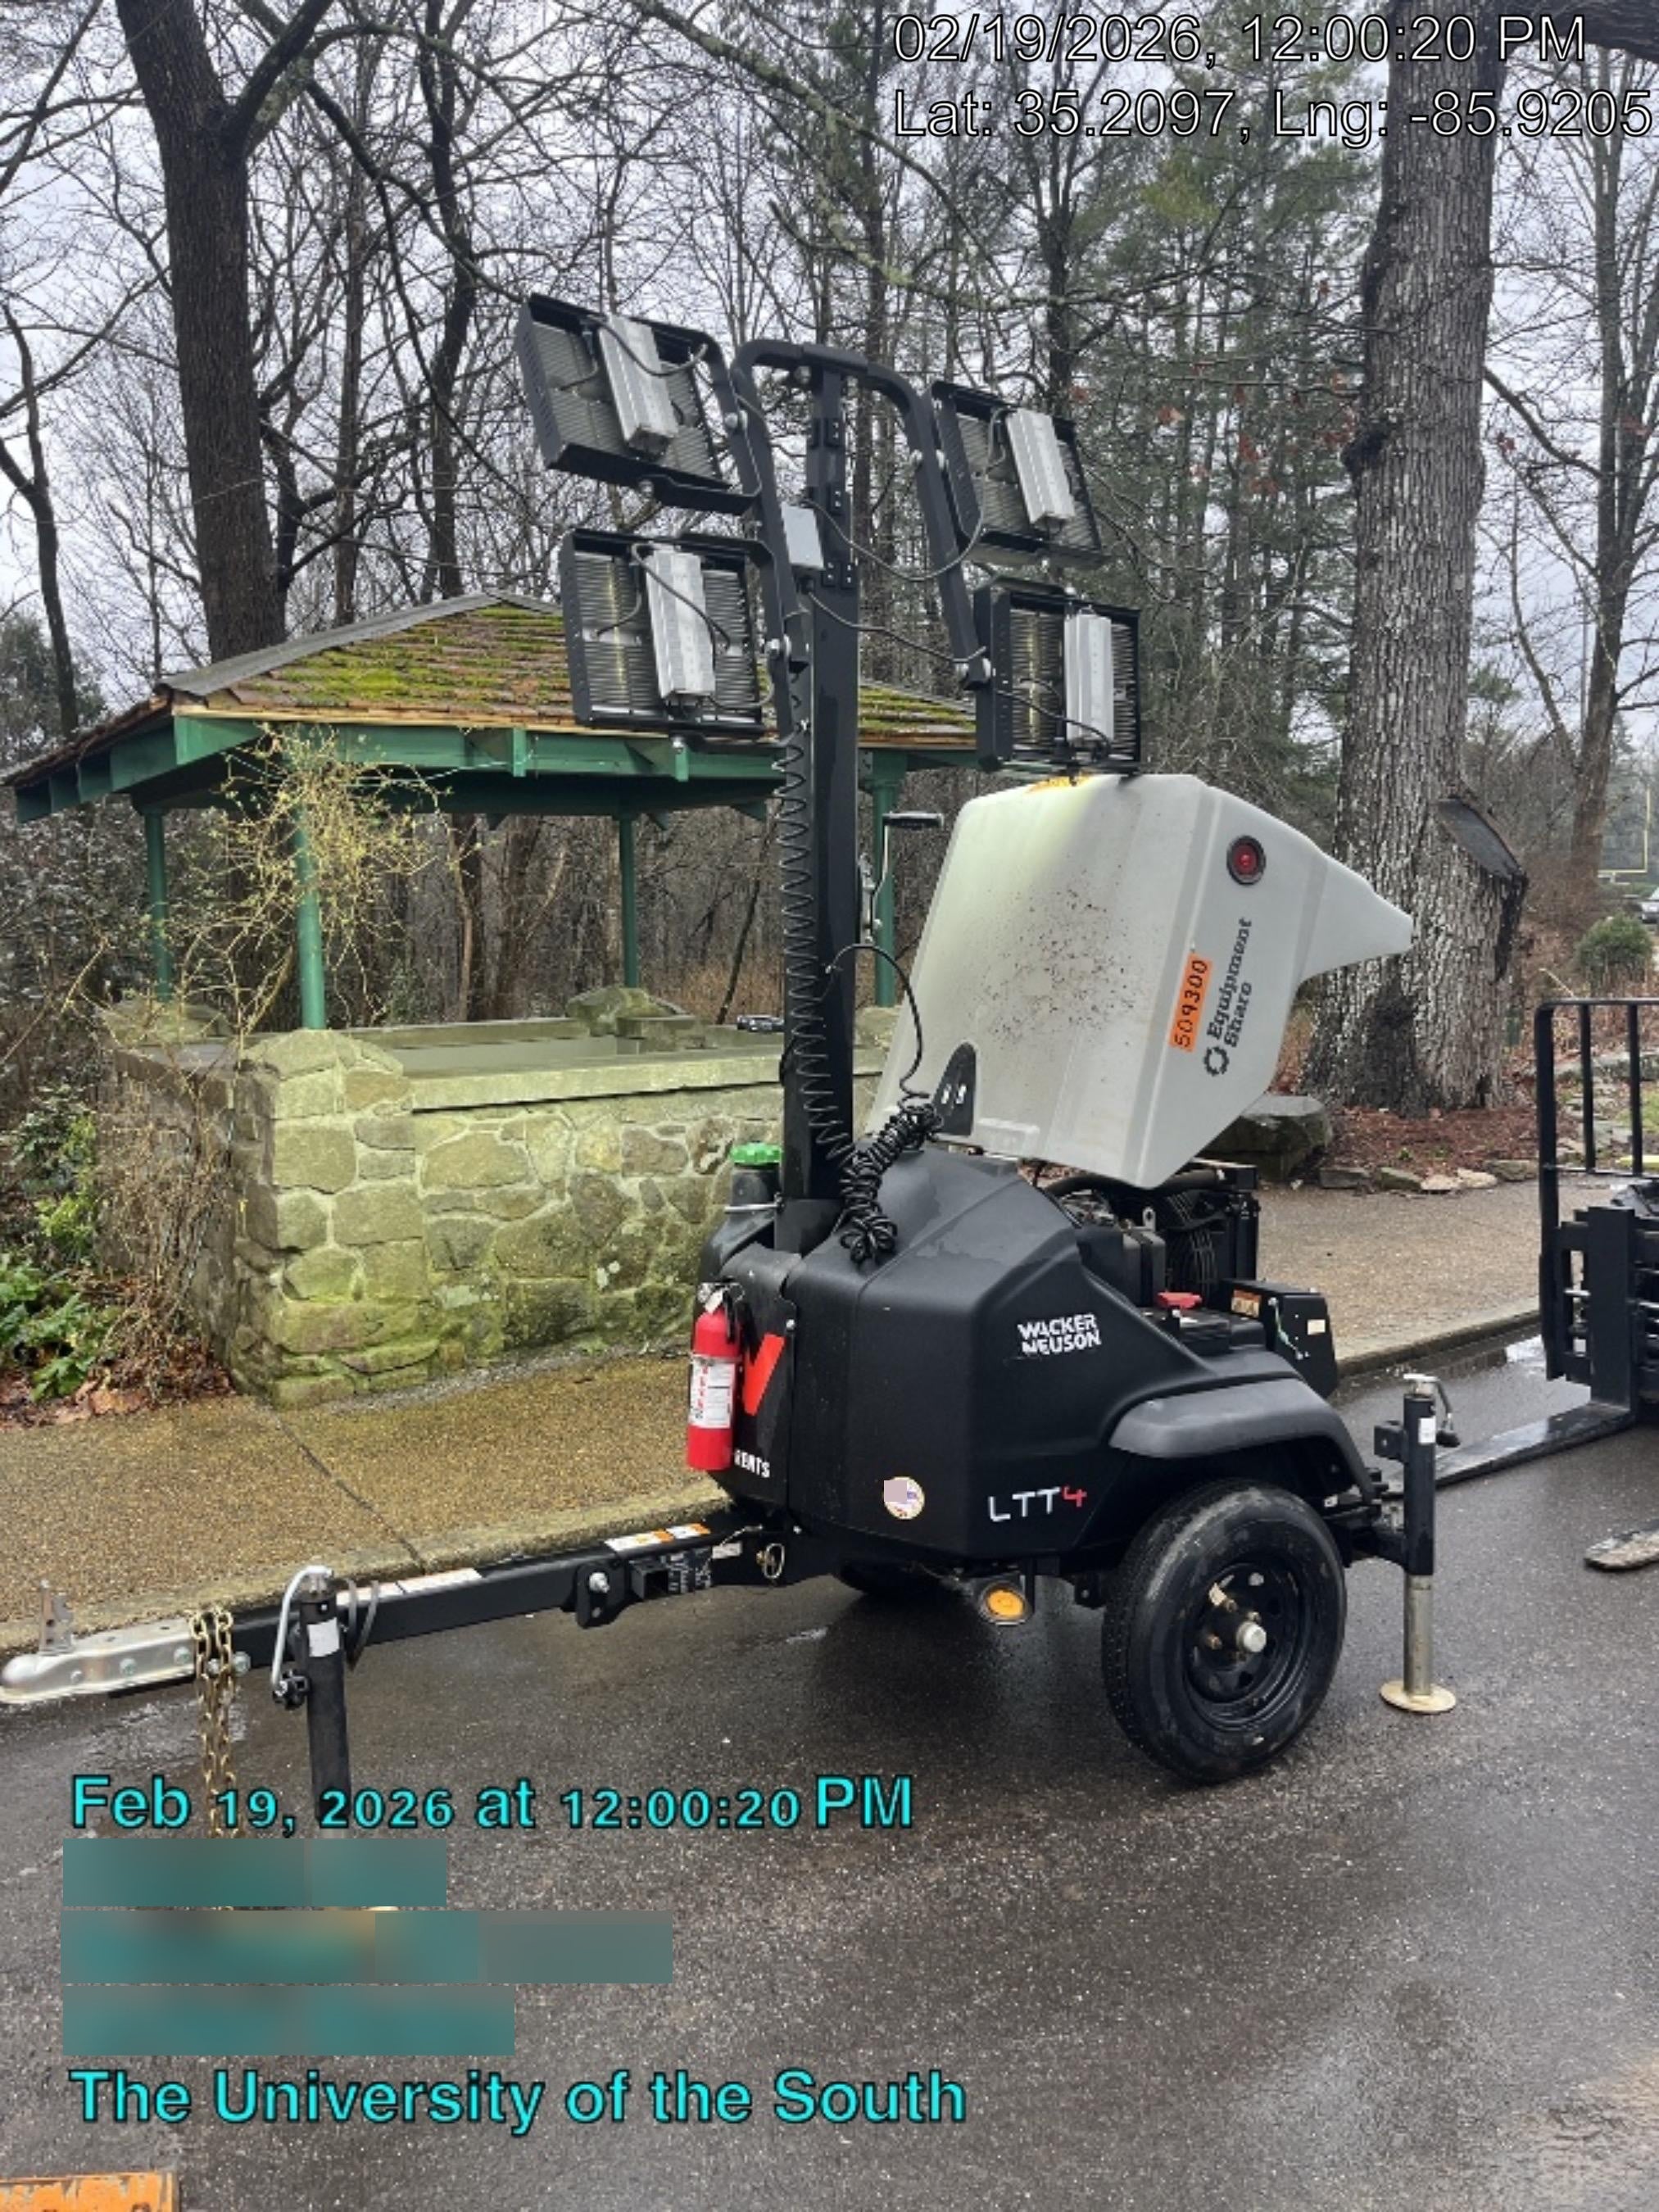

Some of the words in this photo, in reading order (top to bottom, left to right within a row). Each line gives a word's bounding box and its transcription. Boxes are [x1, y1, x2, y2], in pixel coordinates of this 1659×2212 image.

[1173, 959, 1208, 1048] 509300
[1206, 917, 1253, 1040] Equipment
[1223, 981, 1253, 1048] Share
[1017, 1312, 1098, 1340] WACKER
[1021, 1328, 1102, 1355] NEUSON
[987, 1485, 1087, 1522] LTT4
